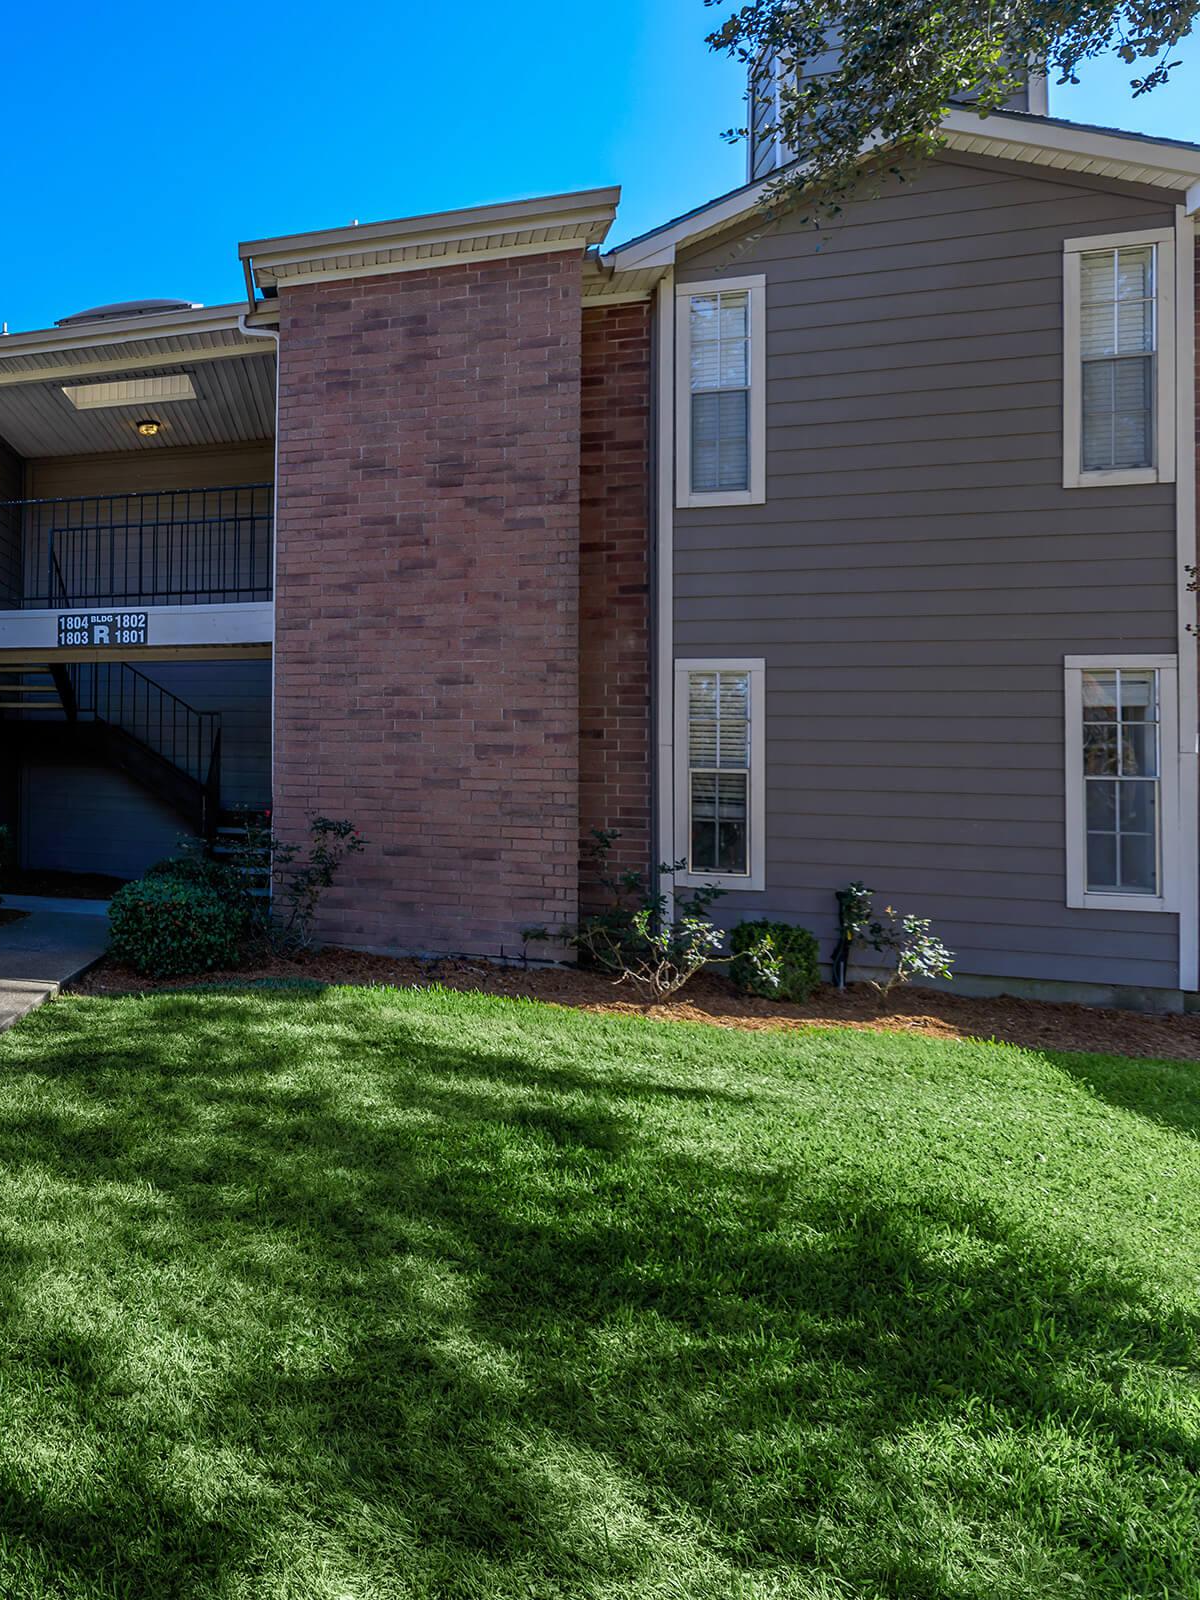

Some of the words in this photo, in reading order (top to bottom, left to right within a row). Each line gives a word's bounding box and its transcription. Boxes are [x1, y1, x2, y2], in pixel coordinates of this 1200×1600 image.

[59, 616, 88, 630] 1804
[90, 615, 113, 623] BLDG
[115, 614, 145, 628] 1802
[59, 631, 88, 645] 1803
[93, 625, 110, 644] R
[115, 629, 144, 643] 1801
